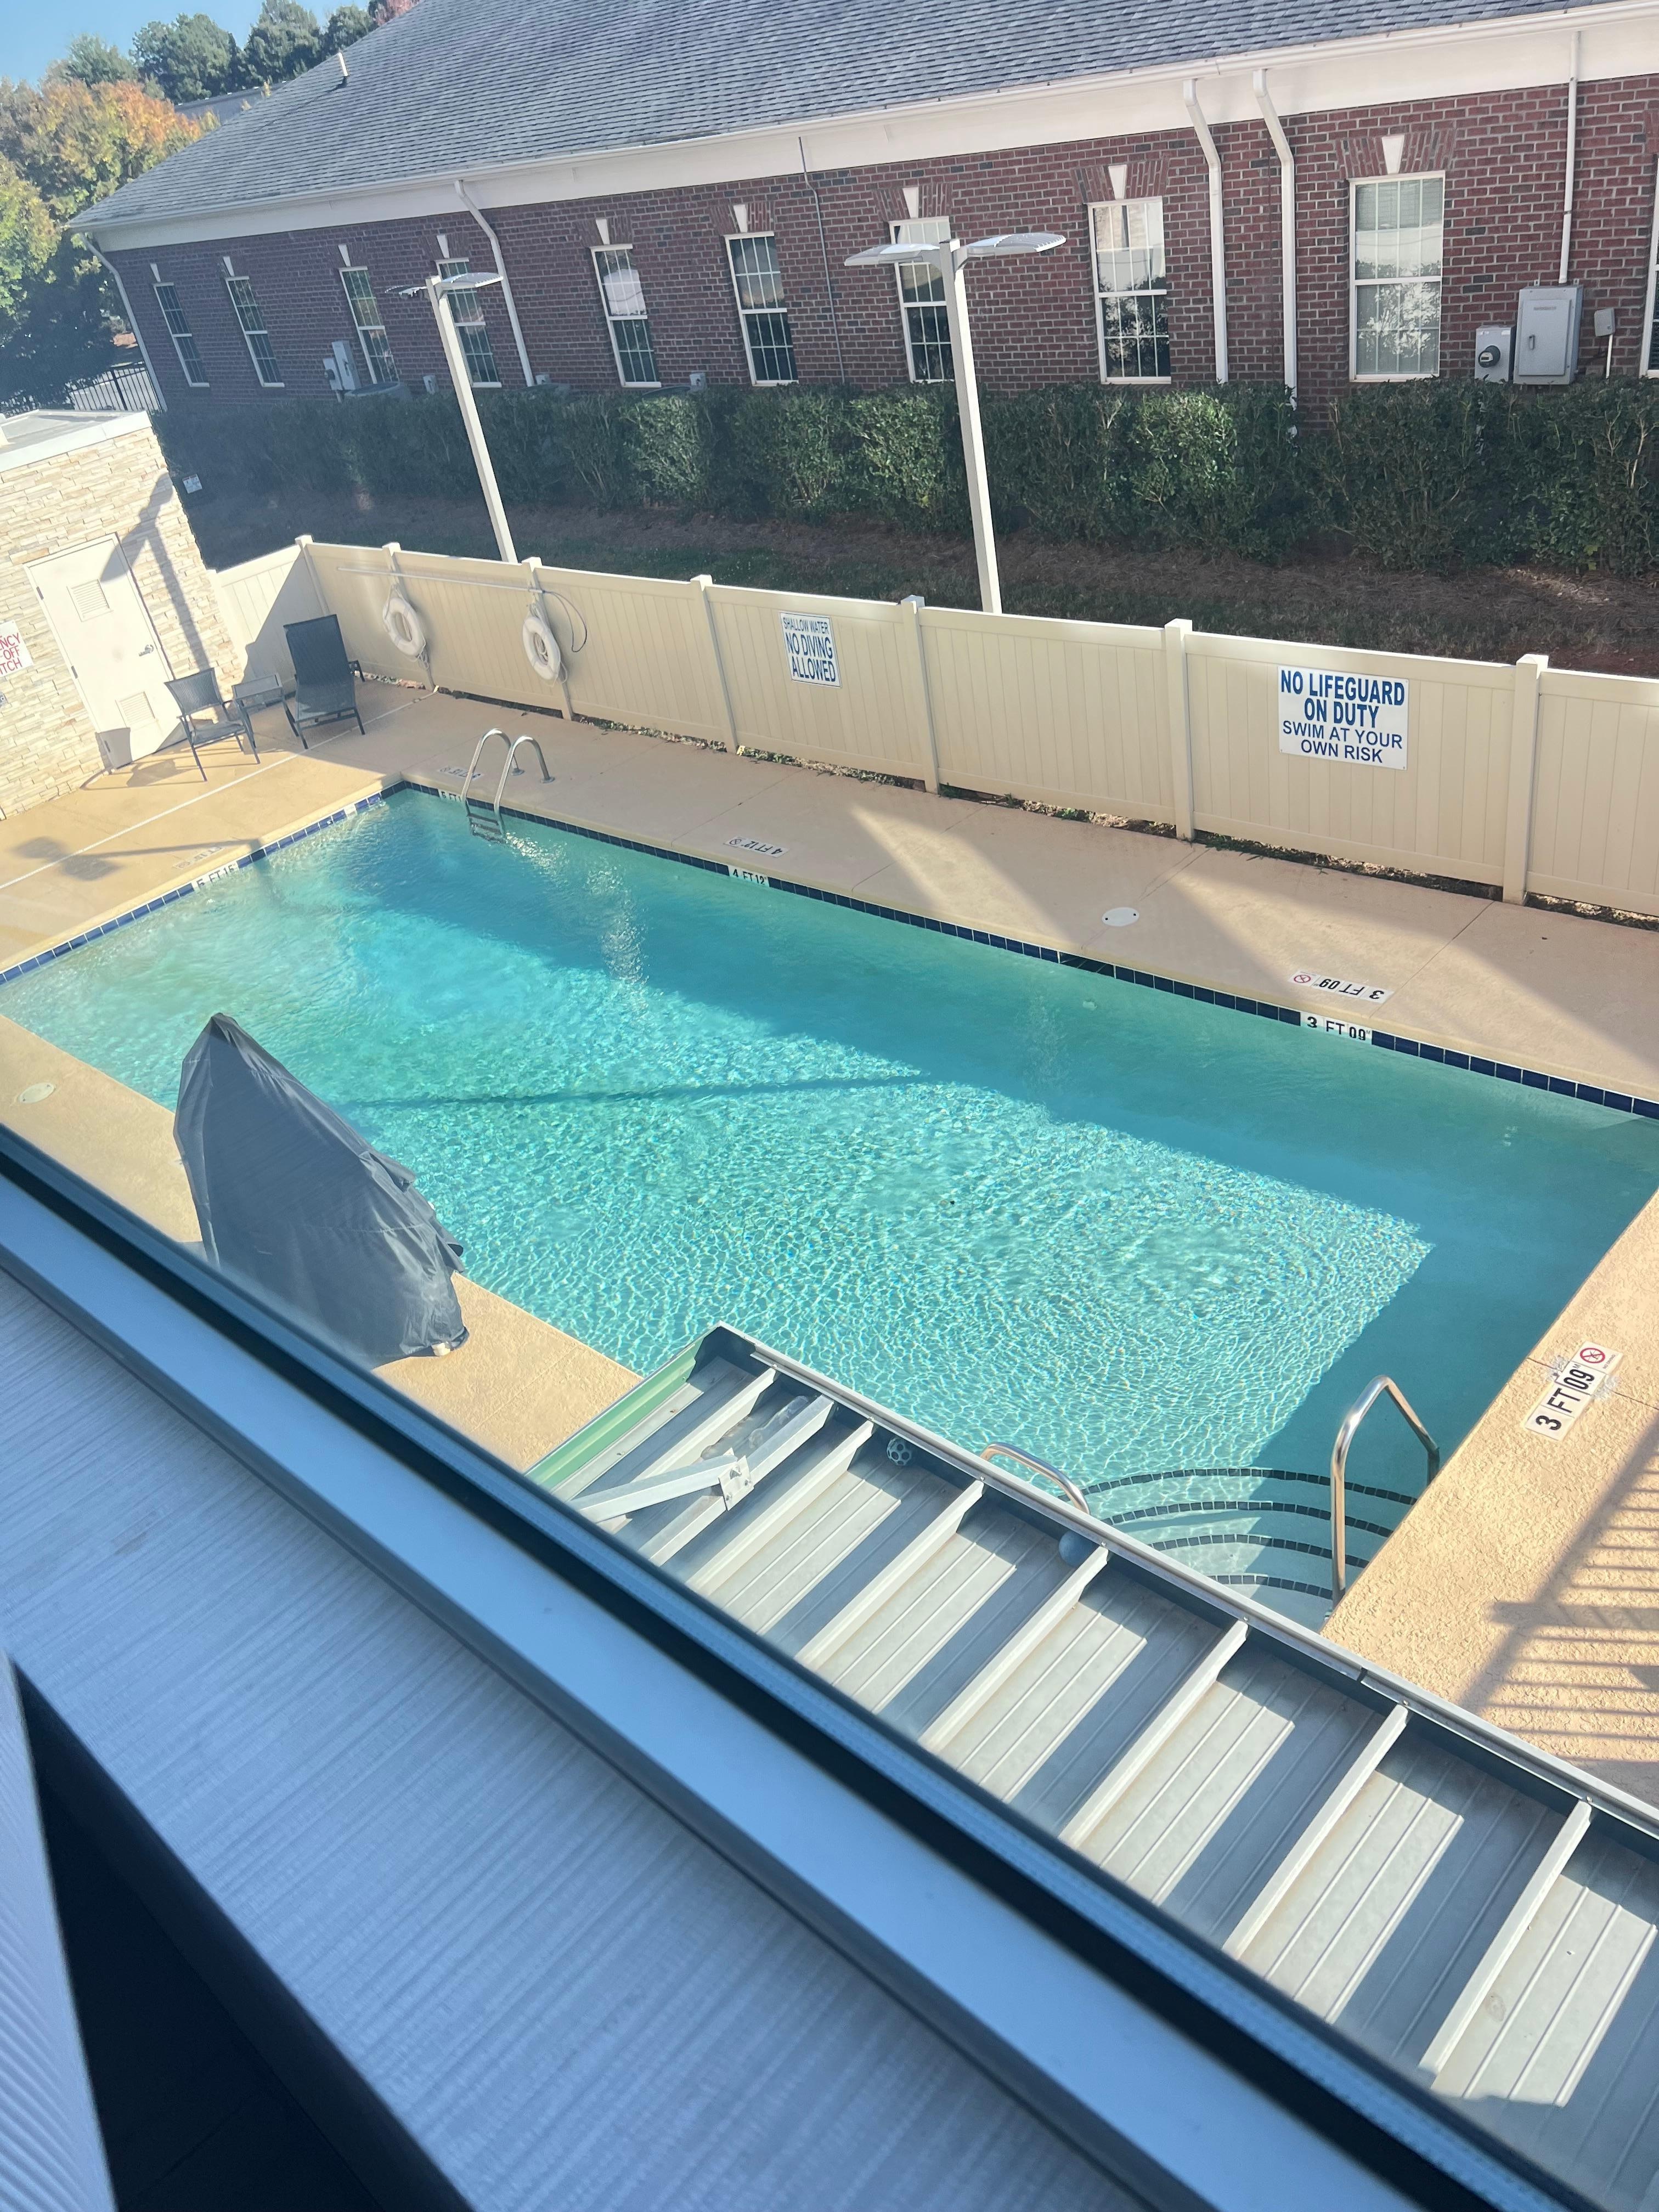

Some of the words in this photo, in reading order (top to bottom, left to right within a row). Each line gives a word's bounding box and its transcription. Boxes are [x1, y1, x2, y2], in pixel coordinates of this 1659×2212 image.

[783, 617, 809, 632] SHALLOW
[809, 620, 829, 635] WATER
[0, 633, 20, 650] NCY
[786, 632, 800, 655] NO
[801, 634, 833, 659] DIVING
[792, 656, 836, 682] ALLOWED
[1281, 670, 1304, 695] NO
[1309, 673, 1405, 706] LIFEGUARD
[1304, 698, 1327, 723] ON
[1334, 701, 1379, 728] DUTY
[1283, 720, 1324, 739] SWIM
[1329, 727, 1350, 742] AT
[1355, 729, 1403, 749] YOUR
[1301, 740, 1339, 757] OWN
[1345, 745, 1383, 763] RISK
[754, 844, 774, 853] FT
[208, 870, 221, 882] FT
[733, 869, 739, 878] 4
[743, 871, 753, 881] FT
[1339, 984, 1365, 996] FT
[1369, 990, 1384, 1000] 3
[1307, 1016, 1317, 1028] 3
[1326, 1020, 1345, 1035] FT
[1546, 1387, 1581, 1414] FT
[1535, 1415, 1562, 1431] 3
